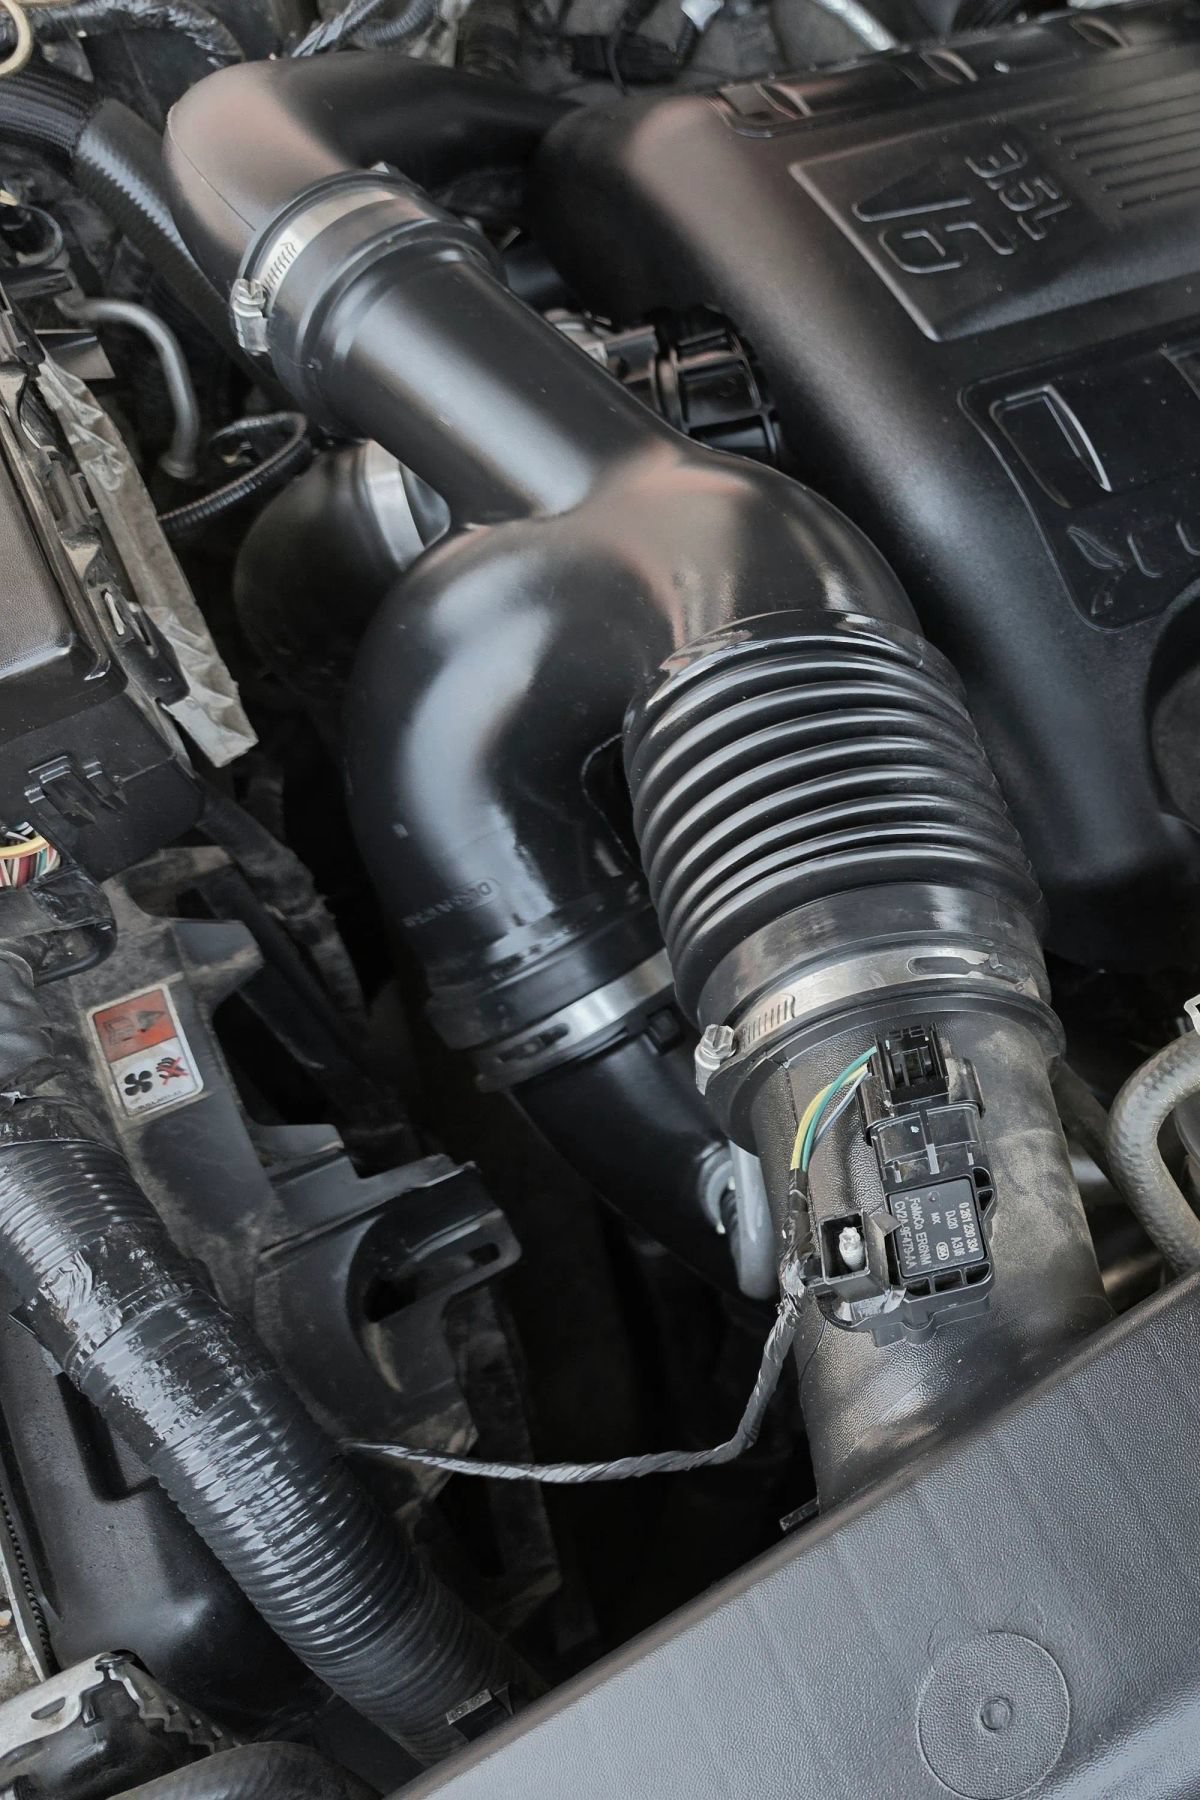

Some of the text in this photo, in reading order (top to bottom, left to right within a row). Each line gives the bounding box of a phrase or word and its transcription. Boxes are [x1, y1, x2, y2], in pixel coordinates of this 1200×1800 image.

[909, 1197, 925, 1230] FoMoCo
[960, 1208, 973, 1223] 261
[963, 1223, 976, 1238] 230
[966, 1238, 979, 1253] 334
